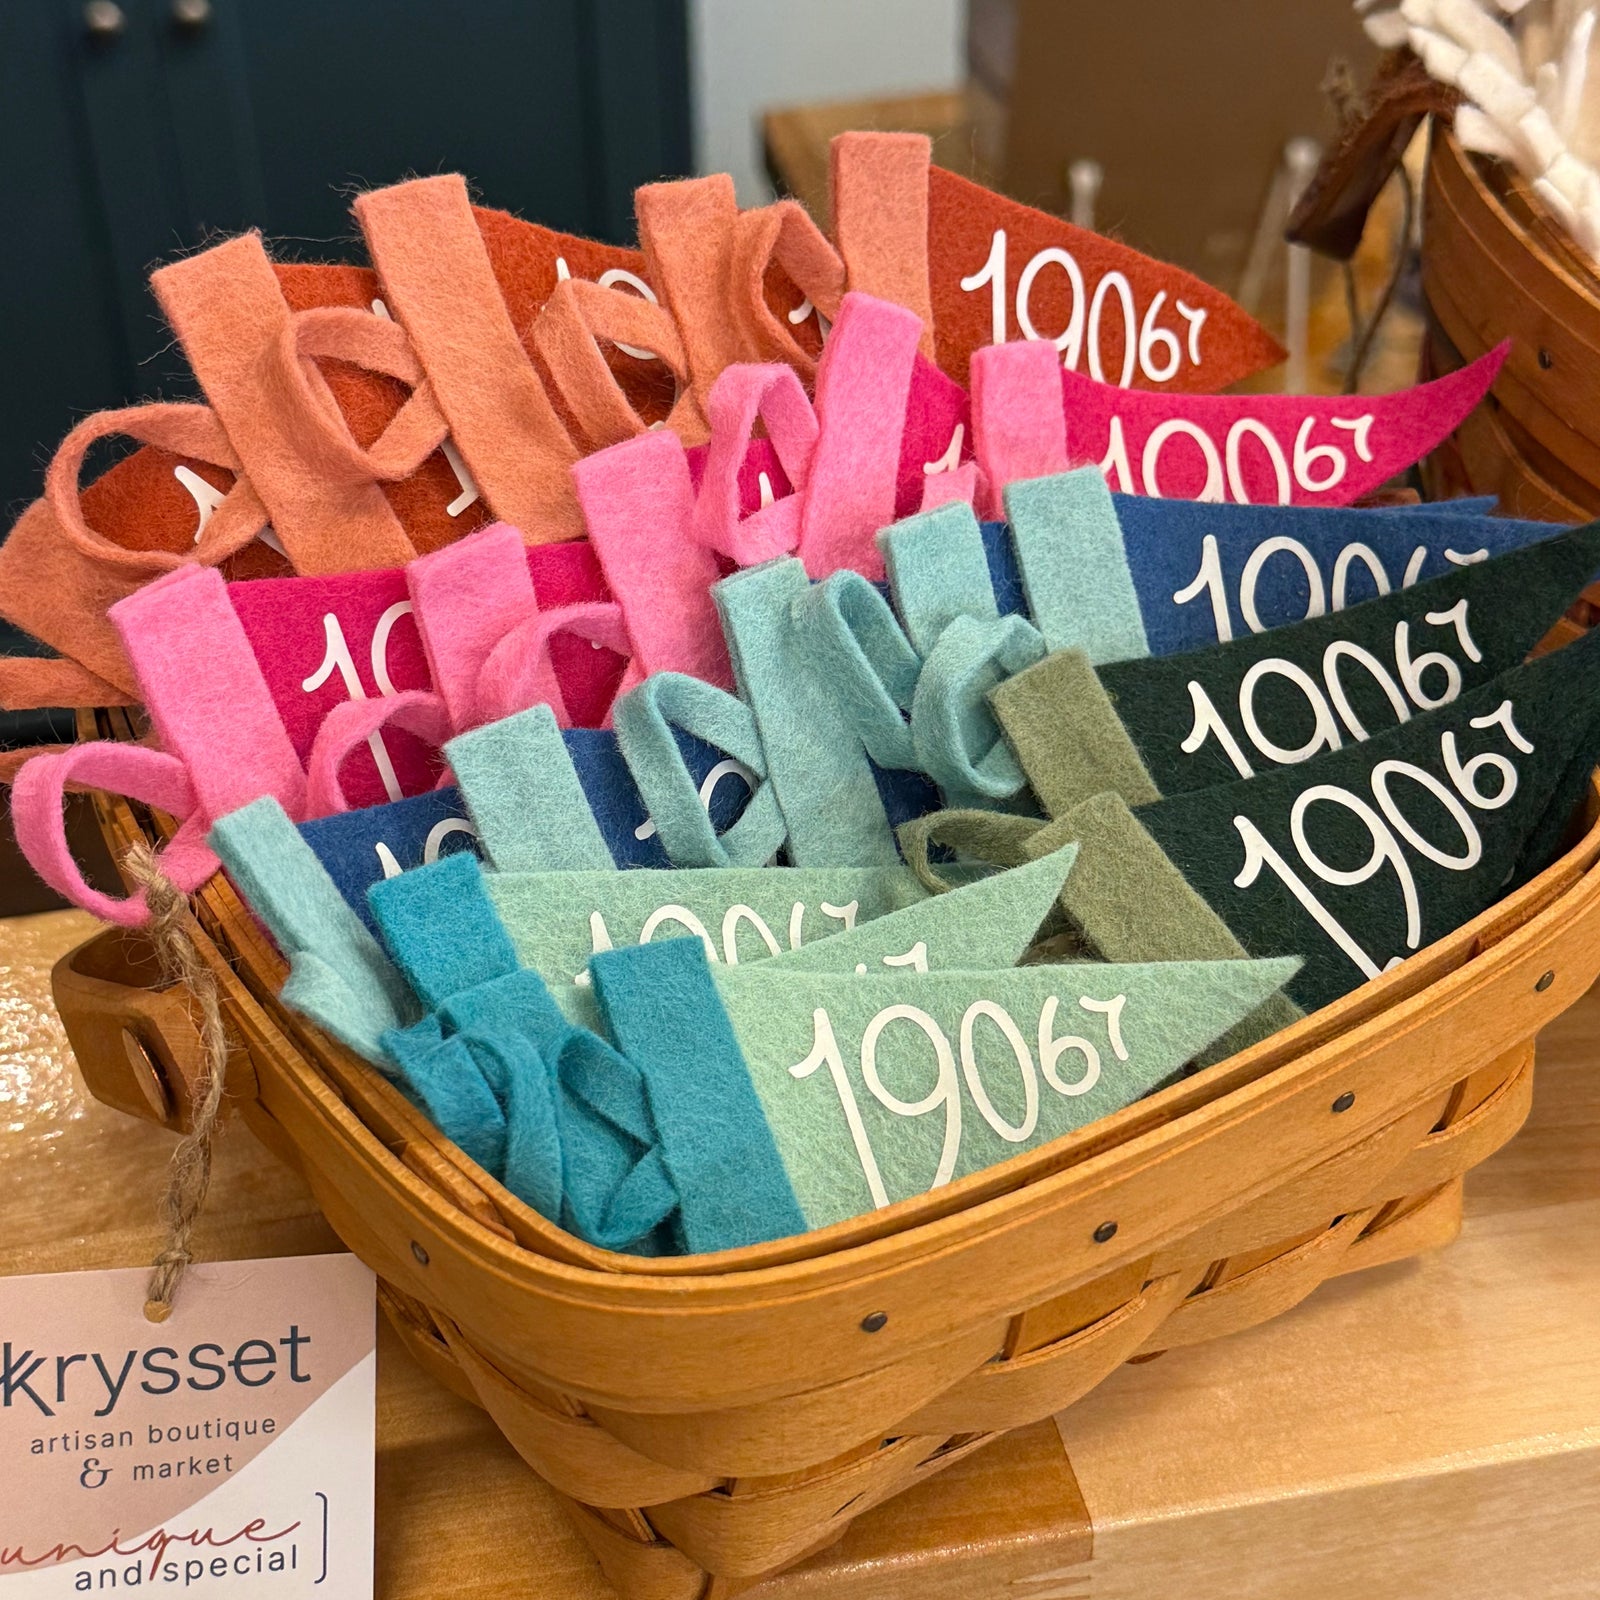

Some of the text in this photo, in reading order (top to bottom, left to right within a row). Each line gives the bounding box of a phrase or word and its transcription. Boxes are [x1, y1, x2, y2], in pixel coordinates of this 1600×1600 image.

[961, 229, 1207, 389] 19067
[1181, 598, 1482, 780] 19067
[1233, 700, 1535, 981] 19067
[788, 994, 1129, 1209] 19067
[0, 1325, 312, 1417] krysset
[30, 1418, 277, 1454] artisan boutique
[80, 1454, 233, 1489] & market
[0, 1518, 301, 1581] unique
[75, 1545, 297, 1591] and special
